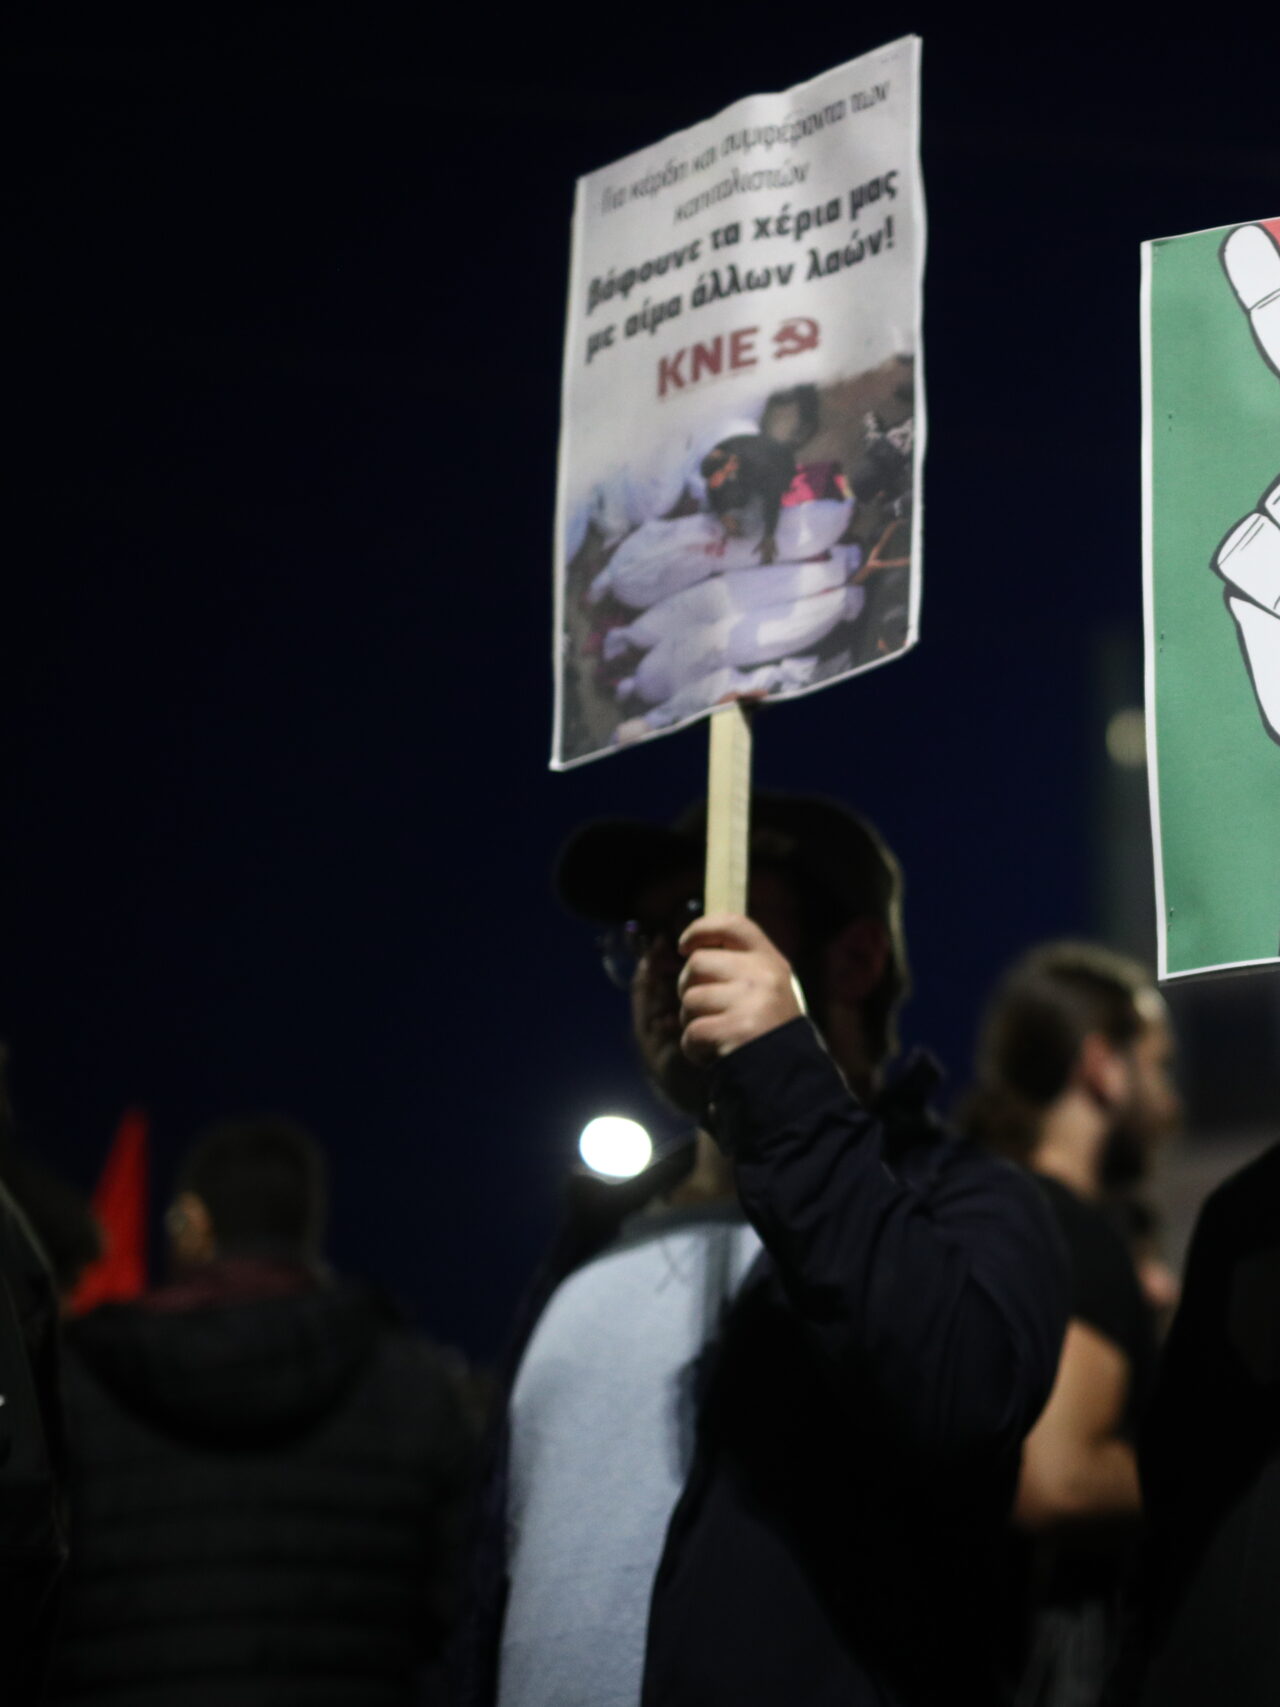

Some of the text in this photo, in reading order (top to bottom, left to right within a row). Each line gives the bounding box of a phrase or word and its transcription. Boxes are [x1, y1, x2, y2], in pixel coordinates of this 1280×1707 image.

[694, 145, 717, 172] και
[851, 82, 890, 113] των
[586, 213, 896, 365] με αίμα άλλων λαών!
[587, 170, 897, 315] βάφουνε τα χέρια μας
